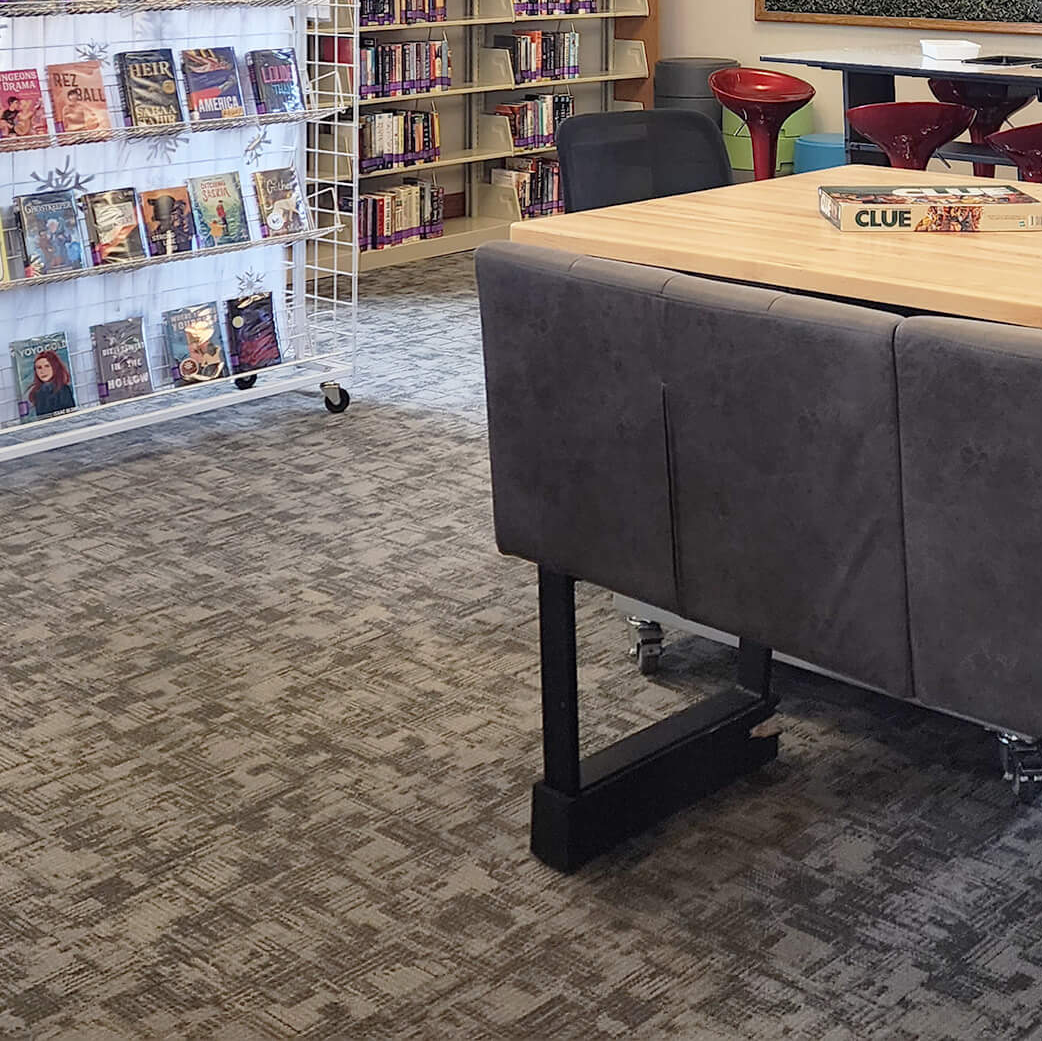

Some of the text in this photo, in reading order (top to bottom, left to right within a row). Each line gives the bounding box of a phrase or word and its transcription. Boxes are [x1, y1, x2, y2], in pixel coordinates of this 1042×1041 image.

[0, 71, 37, 82] NGEONS
[129, 61, 174, 78] HEIR
[2, 80, 36, 93] DRAMA
[53, 73, 79, 88] REZ
[77, 87, 106, 103] BALL
[198, 95, 239, 113] AMERICA
[892, 186, 1019, 198] CLUE
[855, 210, 911, 228] CLUE
[107, 372, 148, 390] HOLLOW
